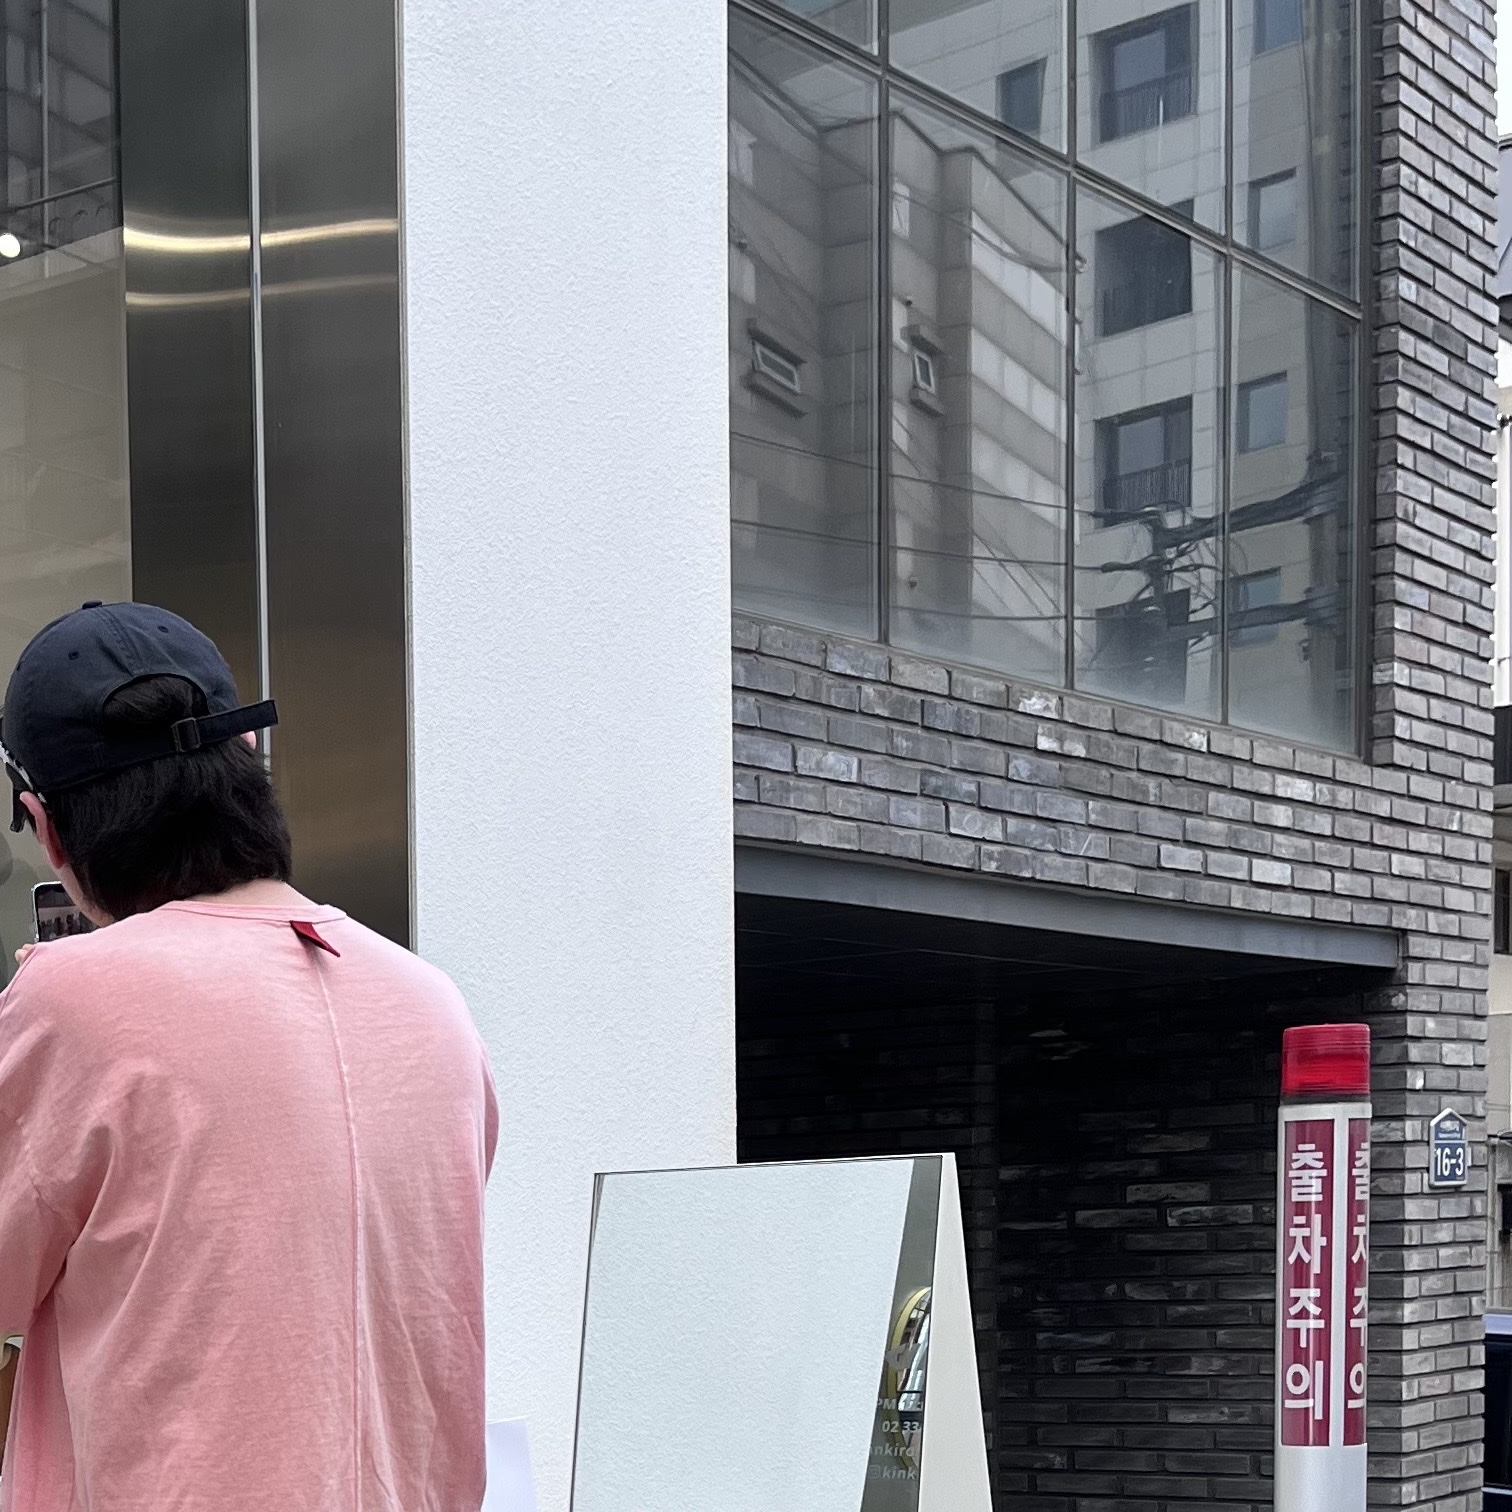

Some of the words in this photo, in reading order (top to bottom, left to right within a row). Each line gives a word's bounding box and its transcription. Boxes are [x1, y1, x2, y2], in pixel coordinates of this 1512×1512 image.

[1435, 1147, 1464, 1176] 16-3
[1284, 1143, 1328, 1420] 출차주의
[882, 1420, 899, 1433] 02
